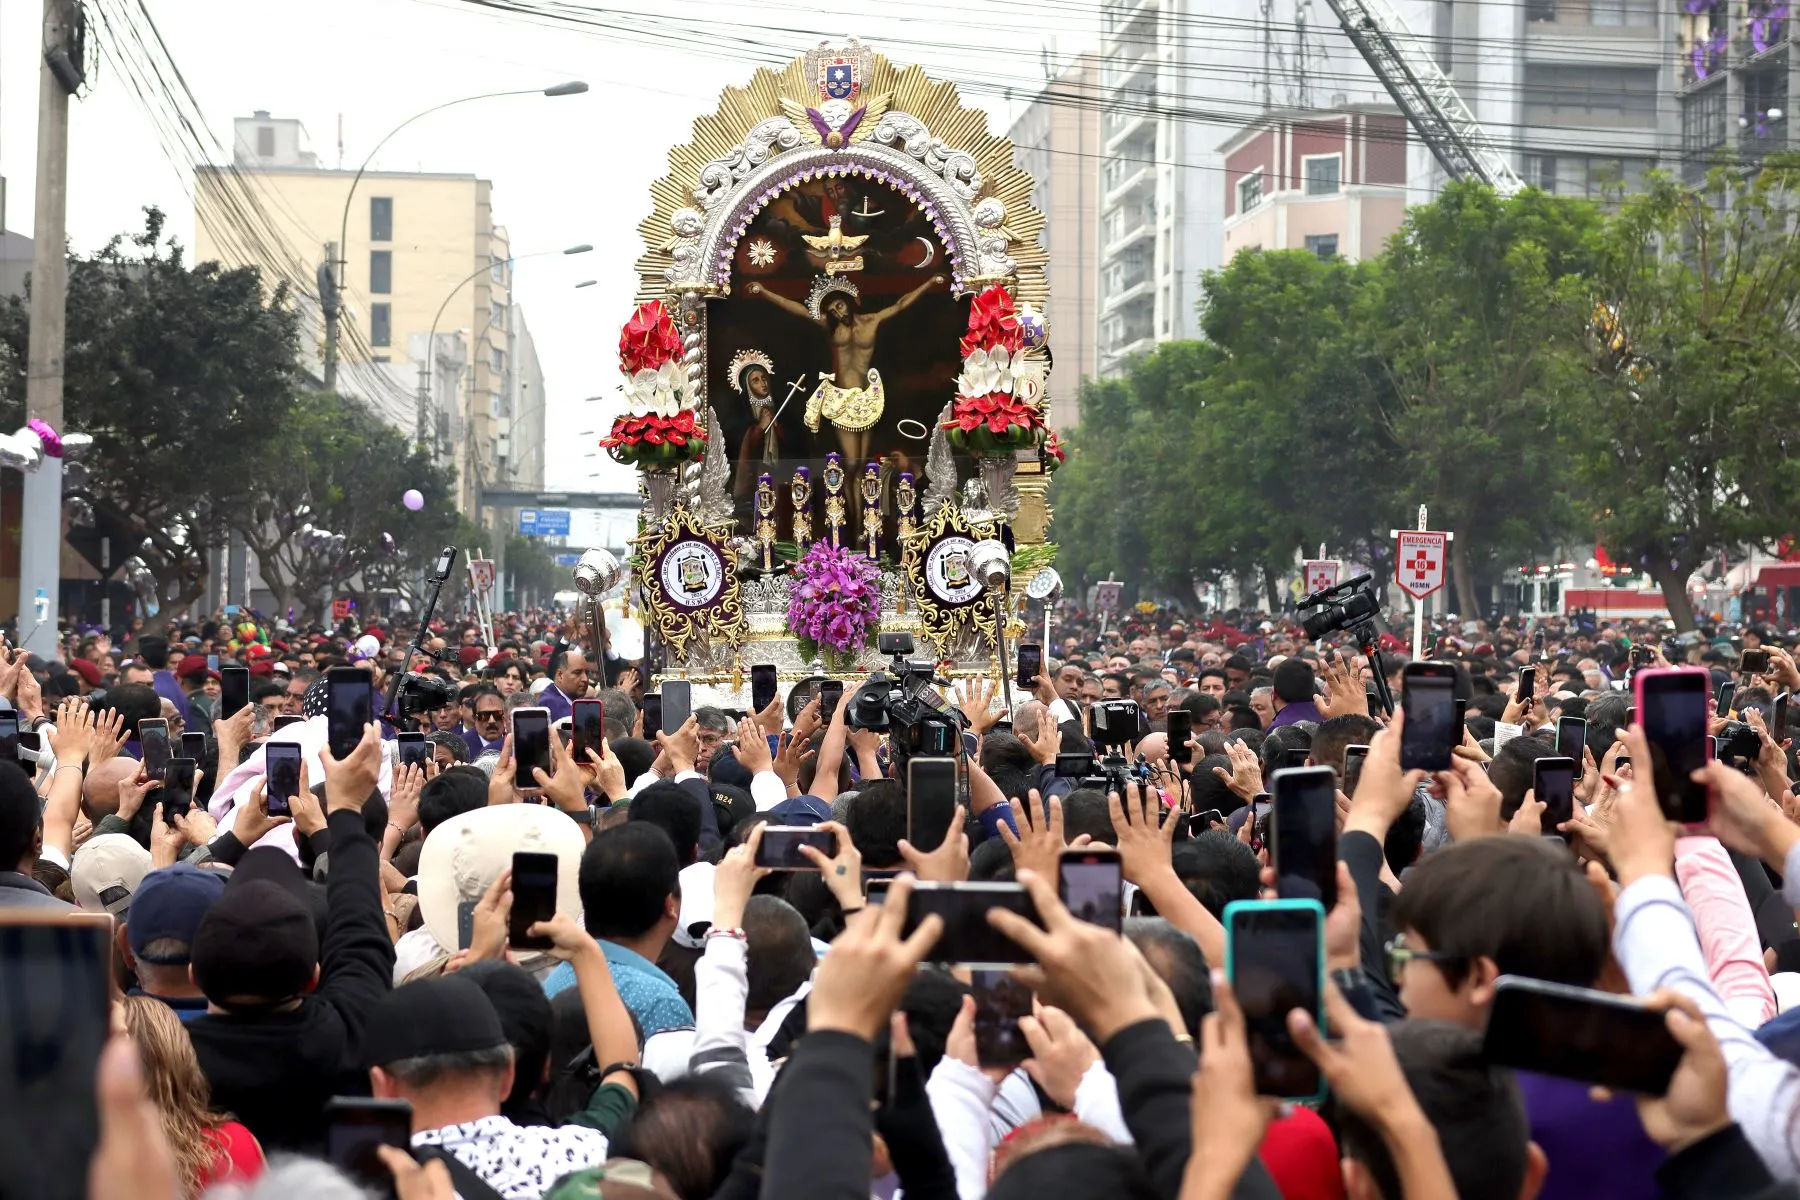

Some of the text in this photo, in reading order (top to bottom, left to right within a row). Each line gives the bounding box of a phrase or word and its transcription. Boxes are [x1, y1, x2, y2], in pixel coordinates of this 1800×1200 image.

[1022, 324, 1035, 339] 15
[1402, 536, 1442, 544] EMERGENCIA
[1416, 560, 1426, 570] 16
[1409, 581, 1430, 589] HSMN
[1125, 705, 1135, 715] 16
